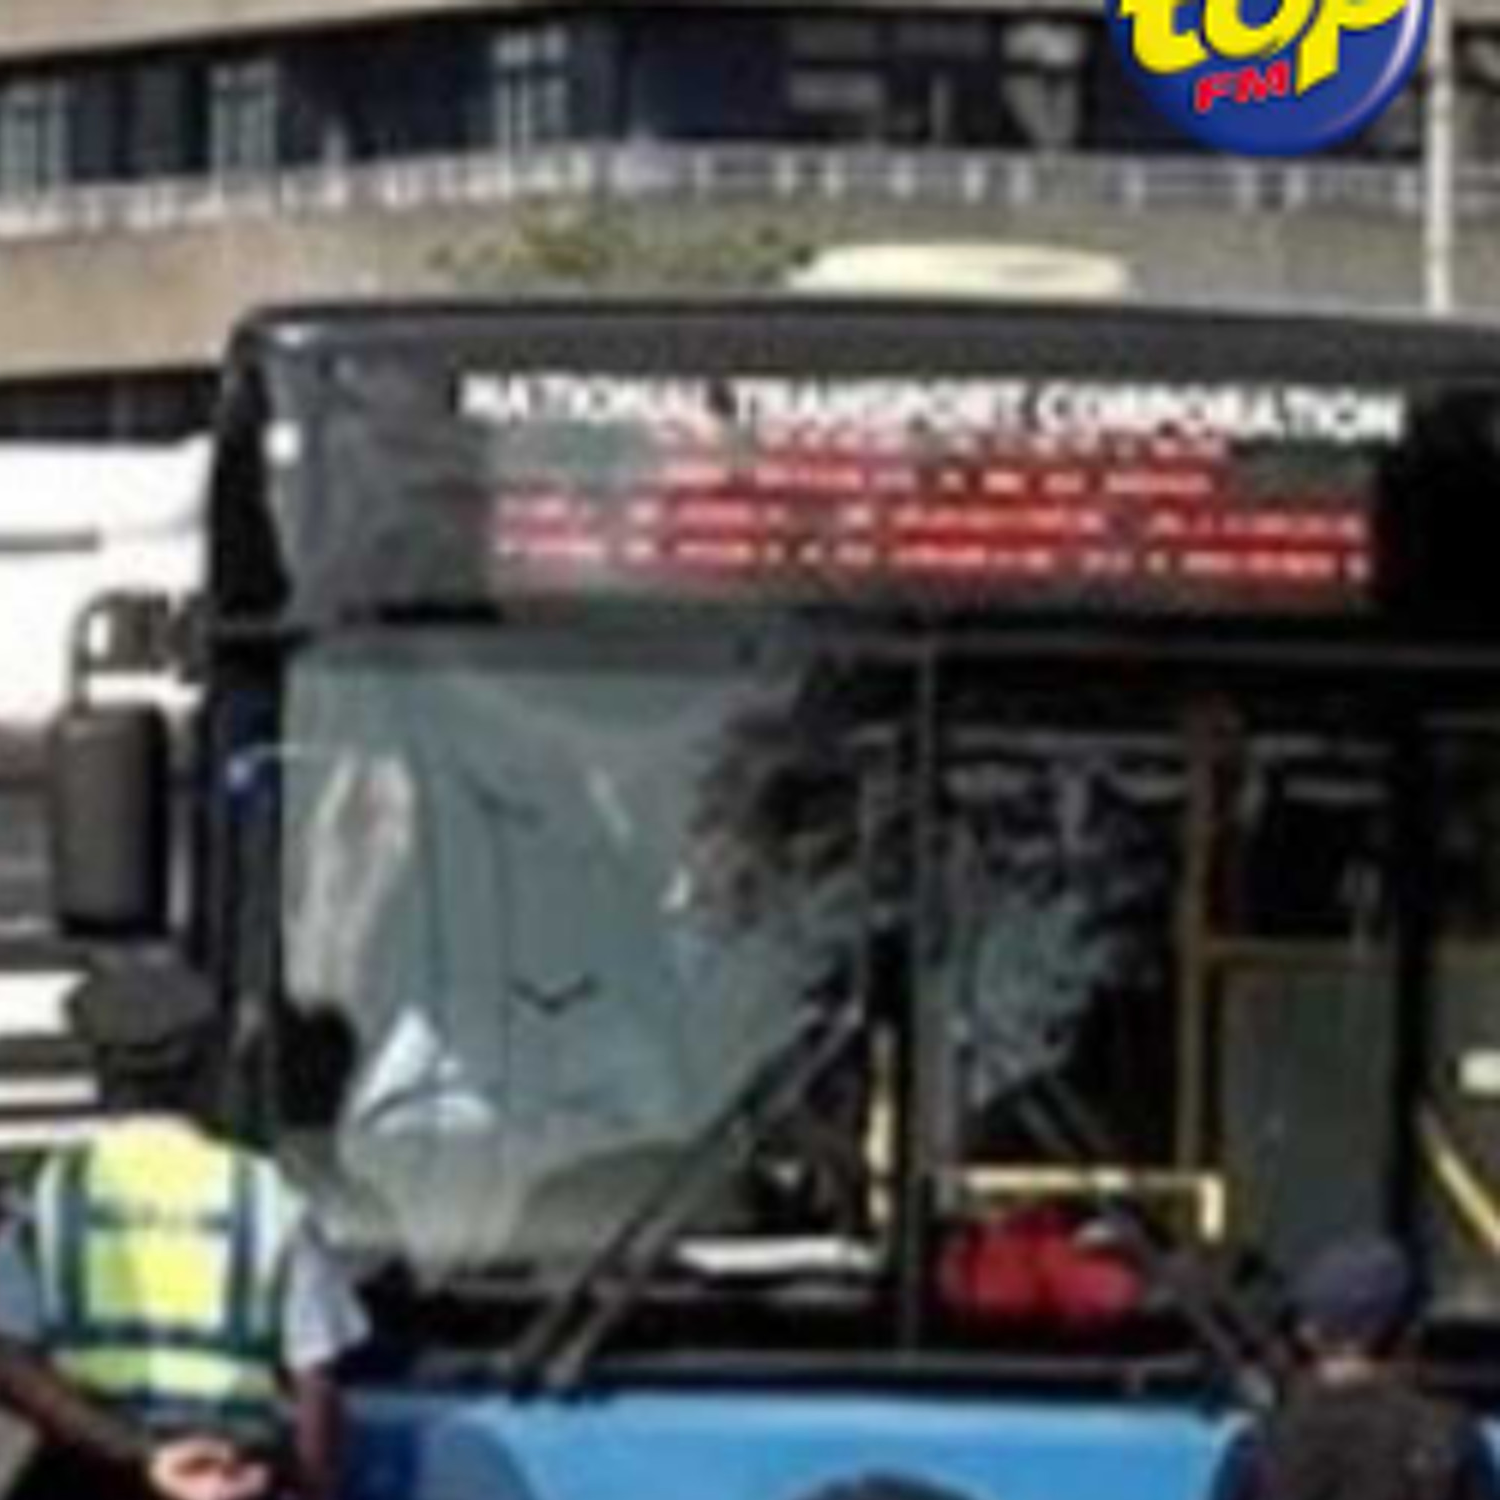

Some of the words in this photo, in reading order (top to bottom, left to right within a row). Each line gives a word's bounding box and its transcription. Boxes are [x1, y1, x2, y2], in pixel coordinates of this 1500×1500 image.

[462, 373, 716, 425] NATIONAL
[732, 376, 1022, 432] TRANSPORT
[1034, 380, 1406, 440] CORPORATION
